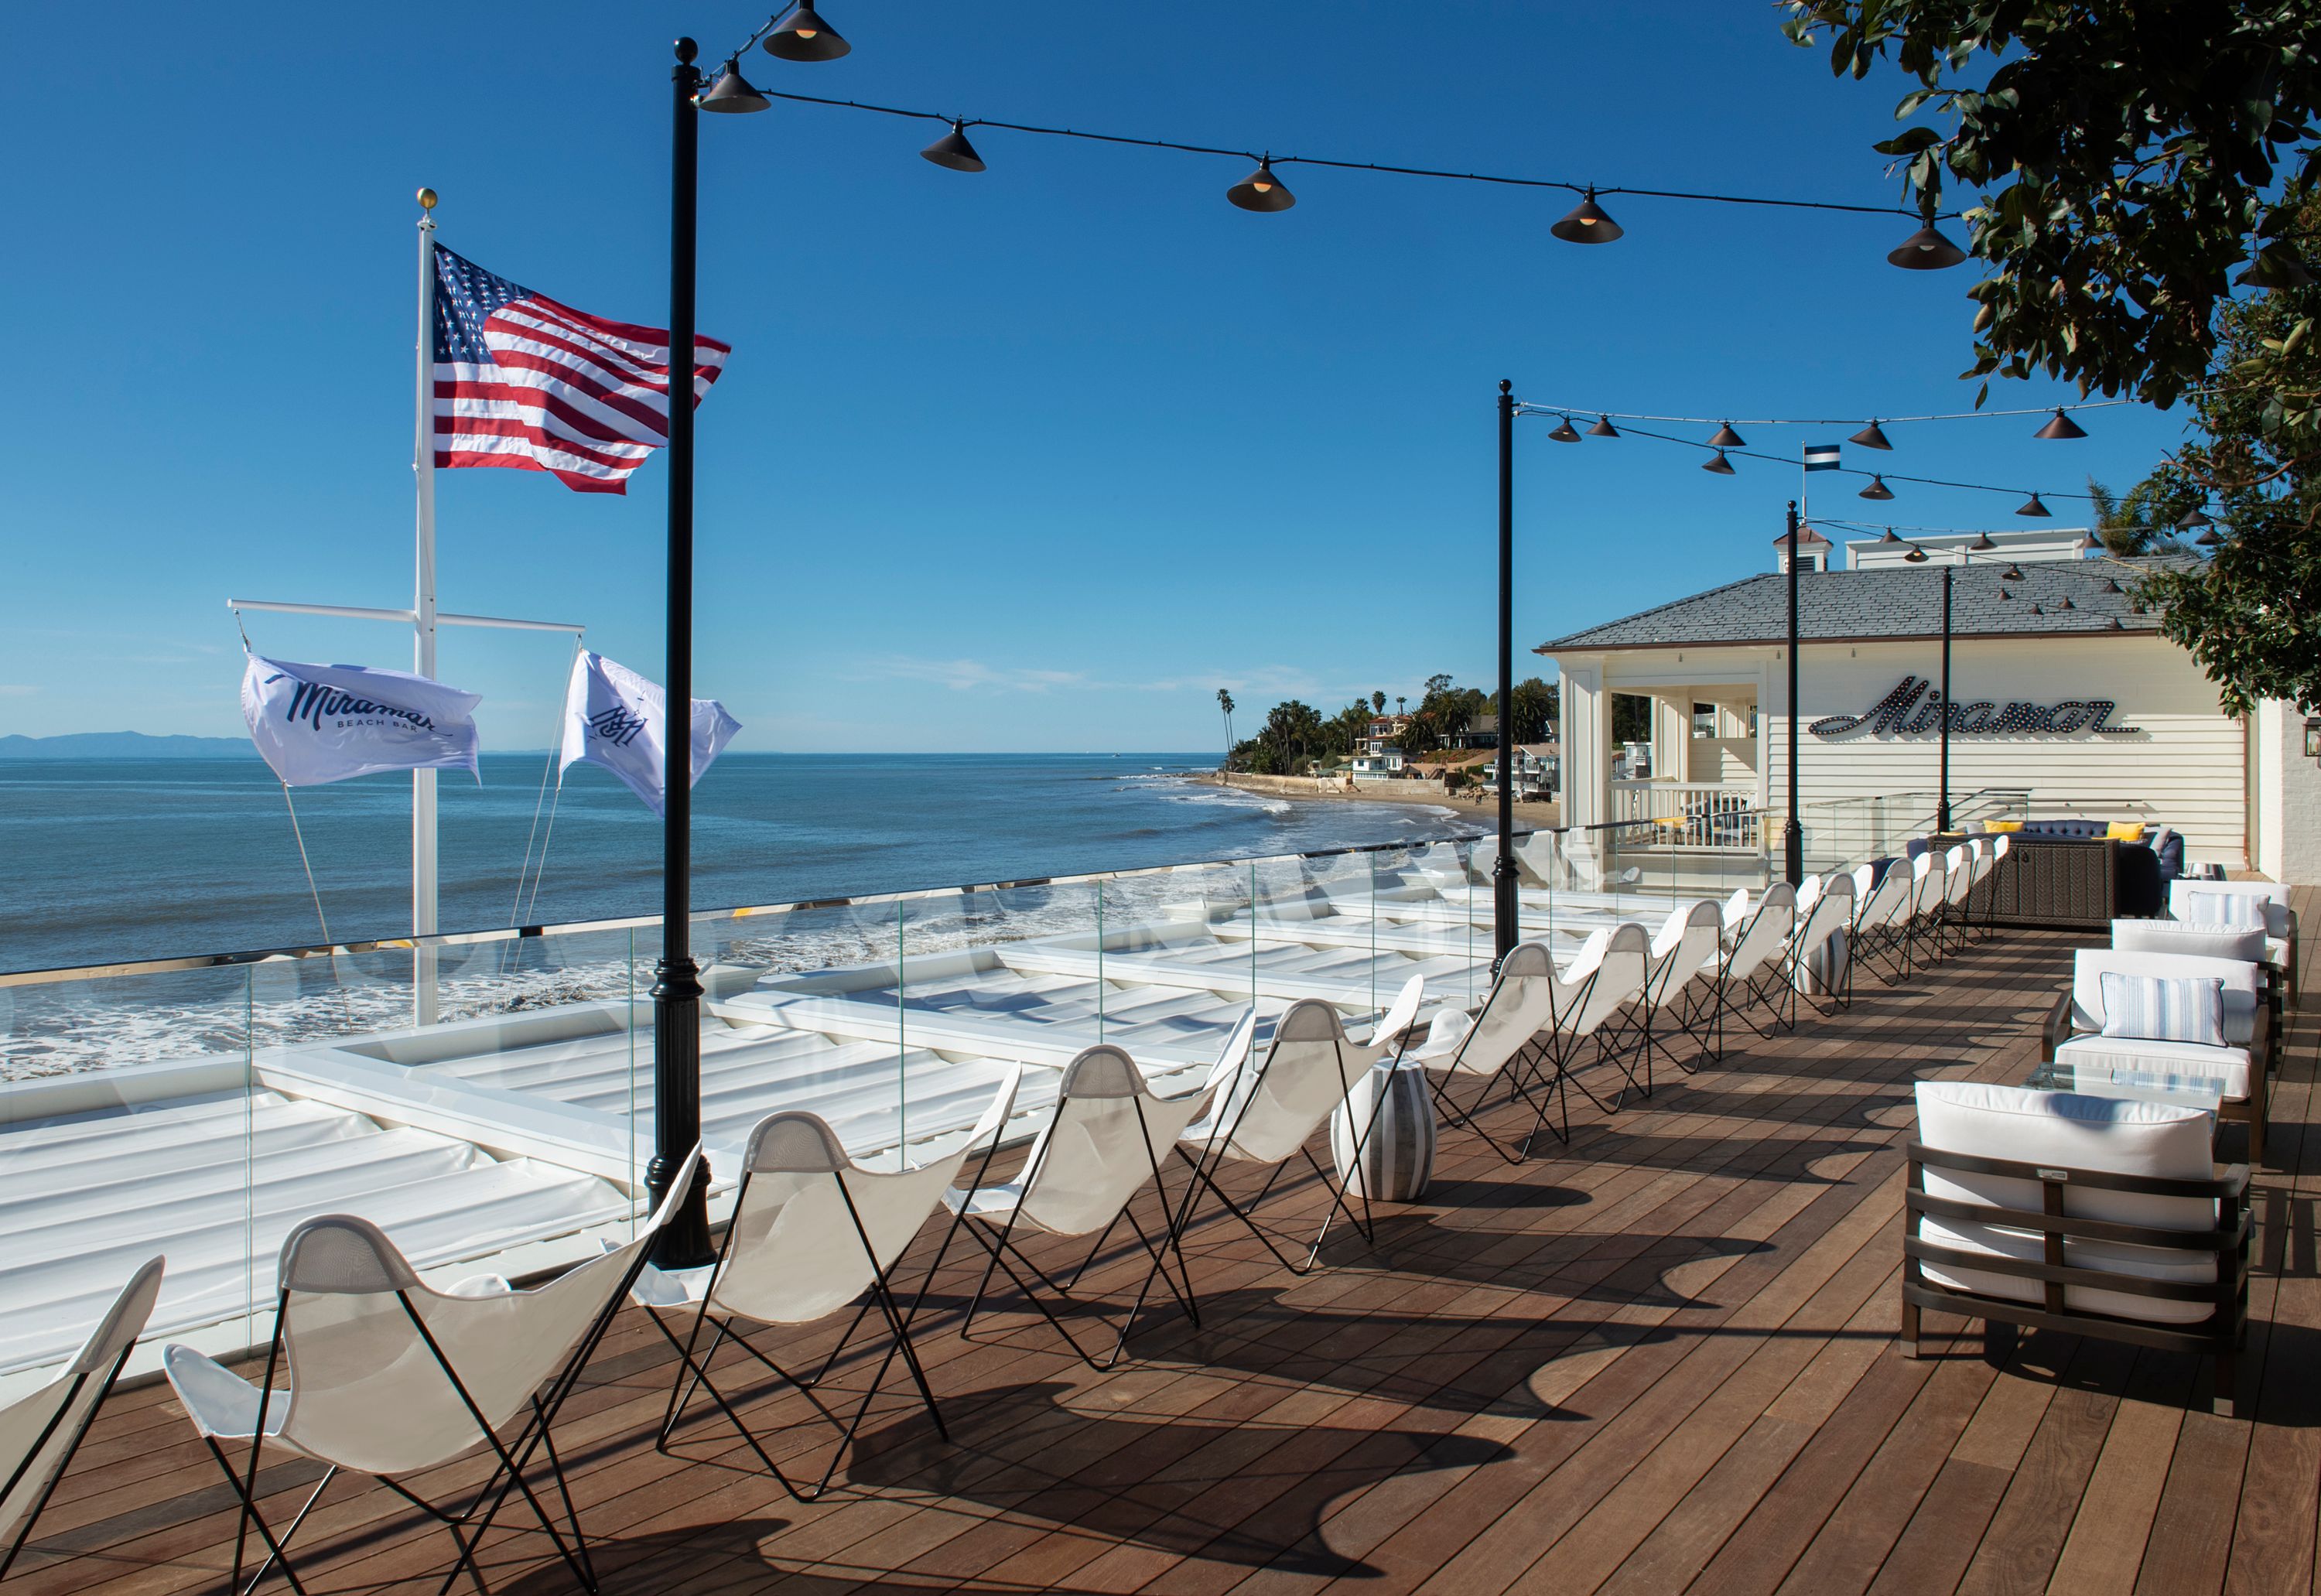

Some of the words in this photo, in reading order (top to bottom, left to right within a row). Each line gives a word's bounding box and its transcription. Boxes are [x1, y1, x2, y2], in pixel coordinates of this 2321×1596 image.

[265, 674, 454, 736] Miramar
[337, 719, 385, 729] BEACH
[392, 721, 418, 733] BAR
[1808, 675, 2141, 736] Miramar
